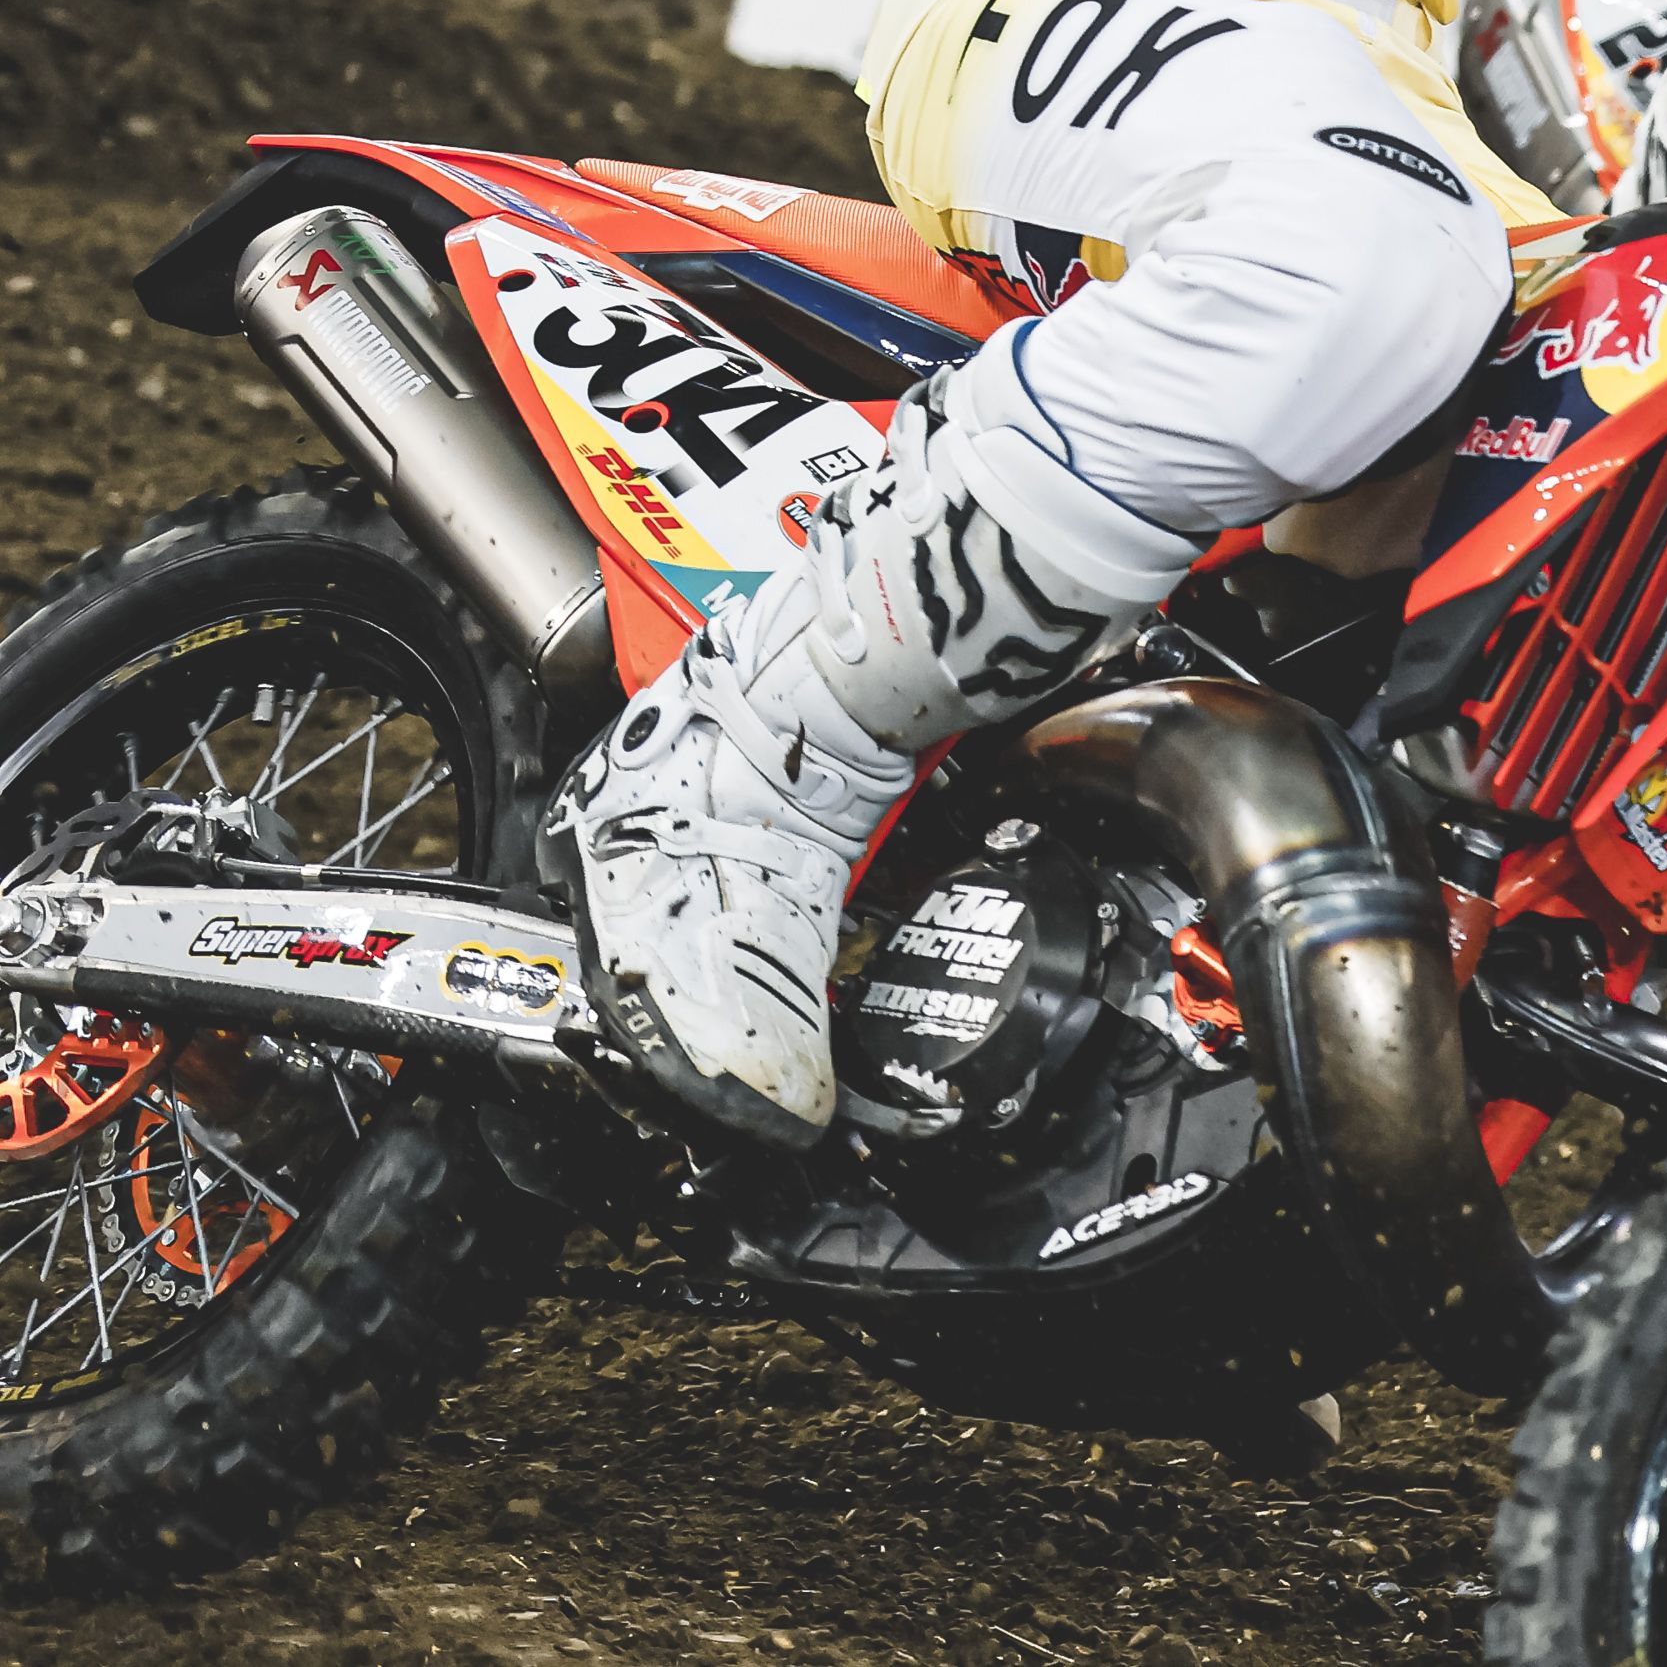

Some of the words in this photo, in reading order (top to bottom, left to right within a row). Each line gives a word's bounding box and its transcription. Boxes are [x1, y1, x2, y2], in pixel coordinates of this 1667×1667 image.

[1329, 132, 1463, 196] ORTEMA
[586, 446, 685, 546] DHL
[911, 883, 1027, 938] KTM
[885, 924, 1025, 970] FACTORY
[617, 992, 666, 1056] FOX
[1039, 1172, 1217, 1261] ACERBIS
